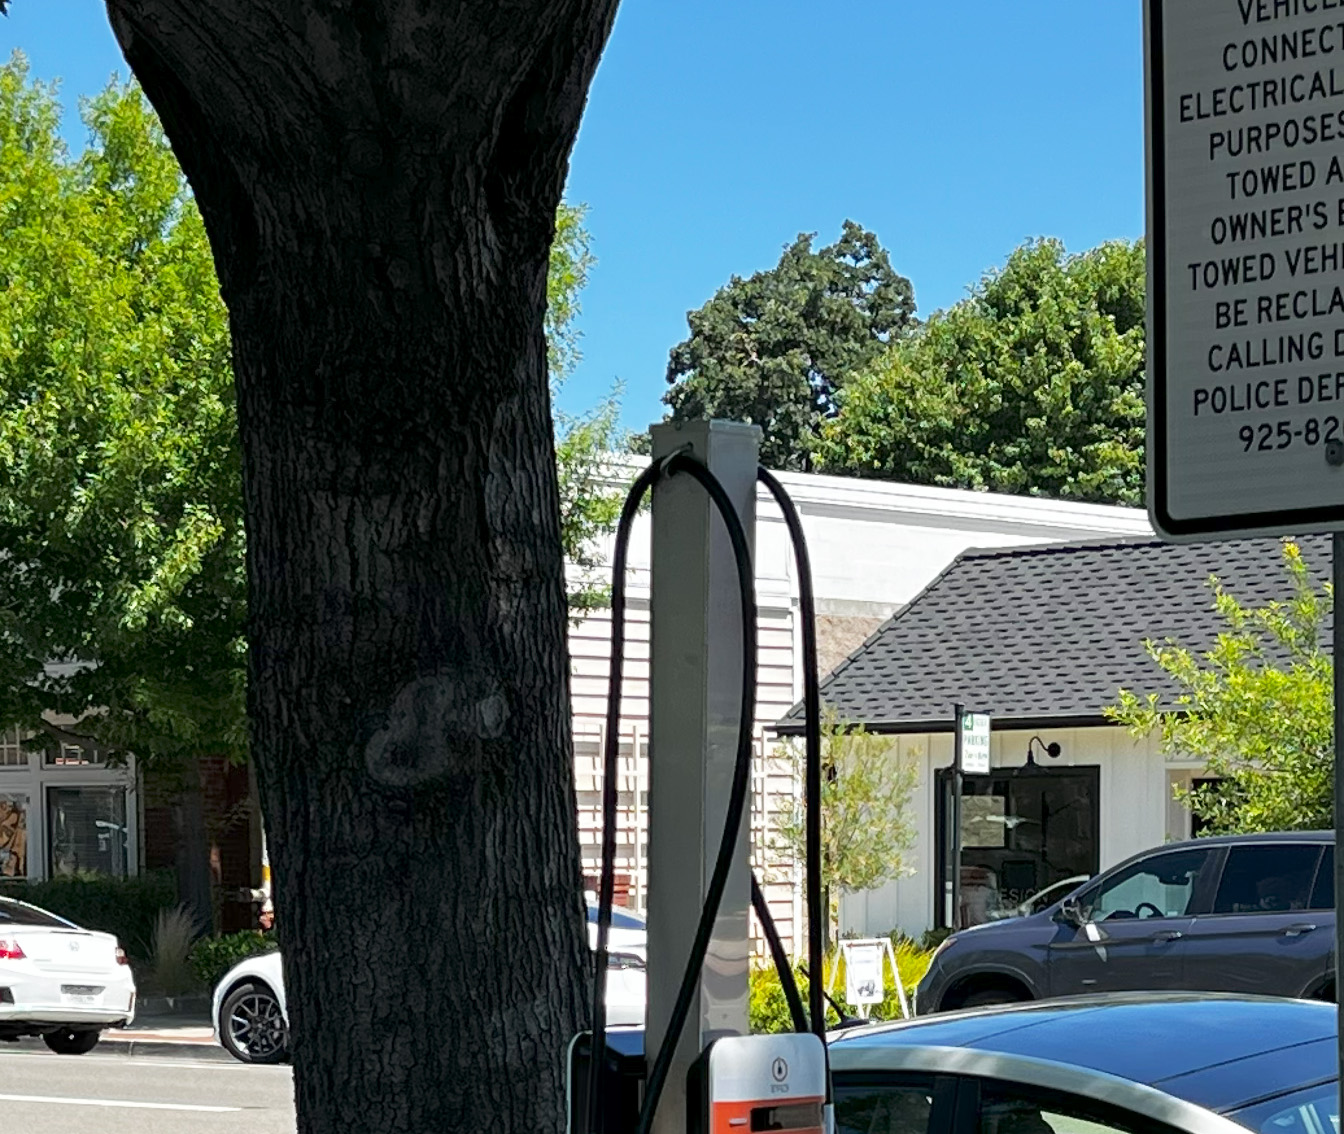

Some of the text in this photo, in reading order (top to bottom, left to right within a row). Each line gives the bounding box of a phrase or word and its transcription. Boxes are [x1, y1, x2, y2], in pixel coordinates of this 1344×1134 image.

[1179, 70, 1344, 123] ELECTRICAL
[1226, 160, 1315, 200] TOWED
[1211, 201, 1328, 245] OWNER'S
[1188, 253, 1275, 290] TOWED
[1216, 298, 1248, 329] BE
[1208, 331, 1323, 372] CALLING
[1194, 379, 1288, 416] POLICE
